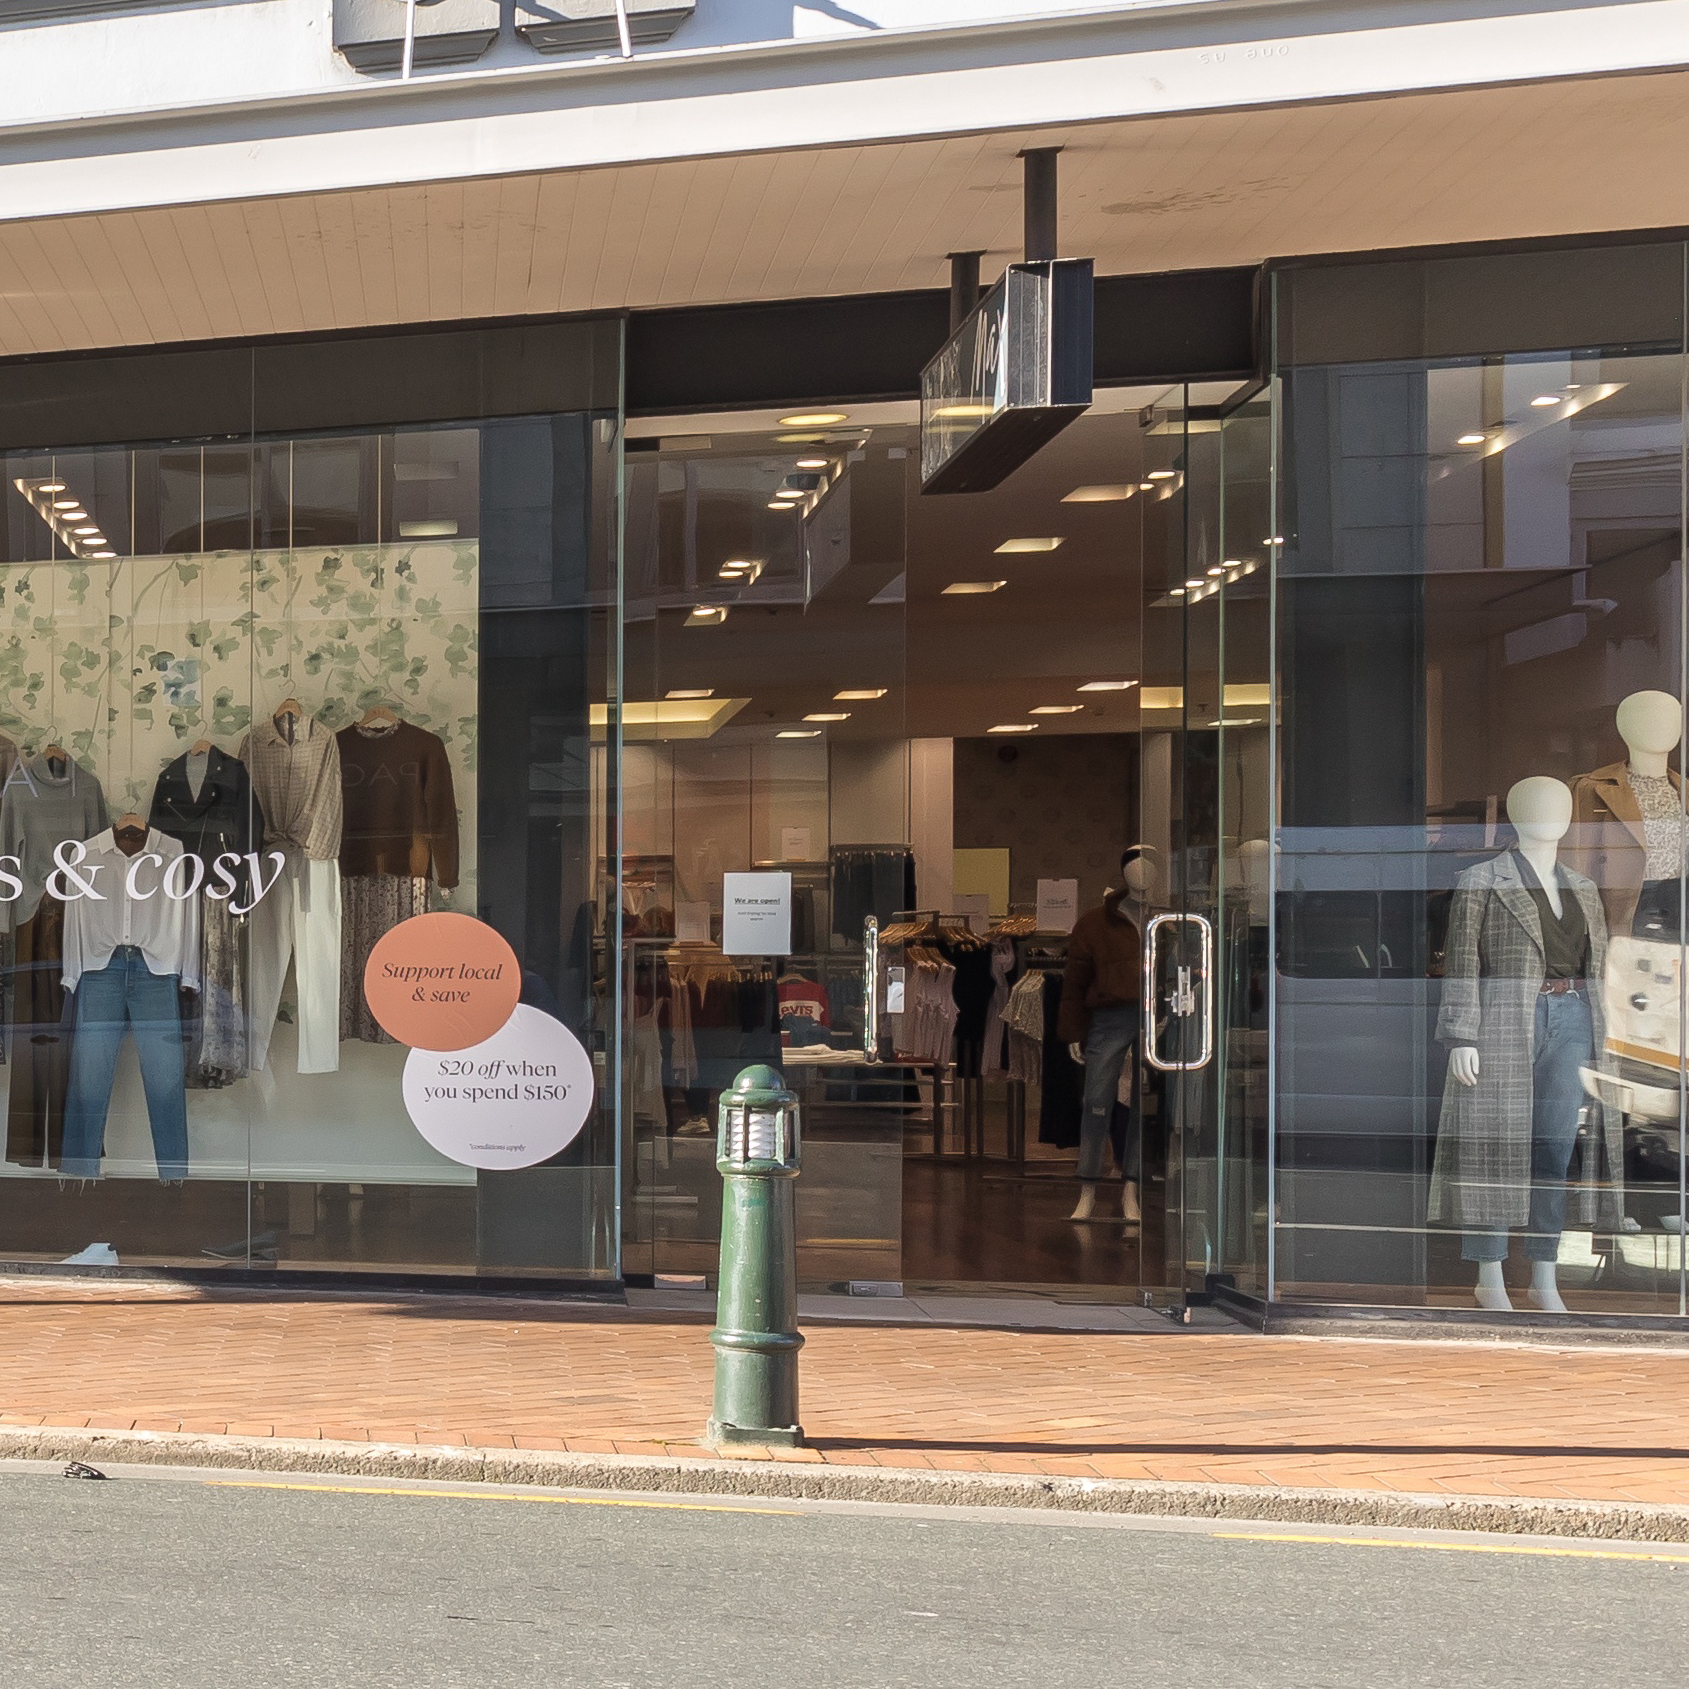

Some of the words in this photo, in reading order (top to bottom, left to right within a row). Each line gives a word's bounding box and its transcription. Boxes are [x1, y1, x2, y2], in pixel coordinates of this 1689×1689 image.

[45, 839, 108, 901] &
[125, 851, 286, 915] cosy
[381, 962, 455, 983] Support
[458, 963, 503, 980] local
[411, 986, 426, 1002] &
[429, 989, 471, 1003] save
[437, 1060, 474, 1077] $20
[477, 1059, 506, 1080] off
[507, 1061, 557, 1078] when
[424, 1086, 457, 1103] you
[462, 1084, 519, 1103] spend
